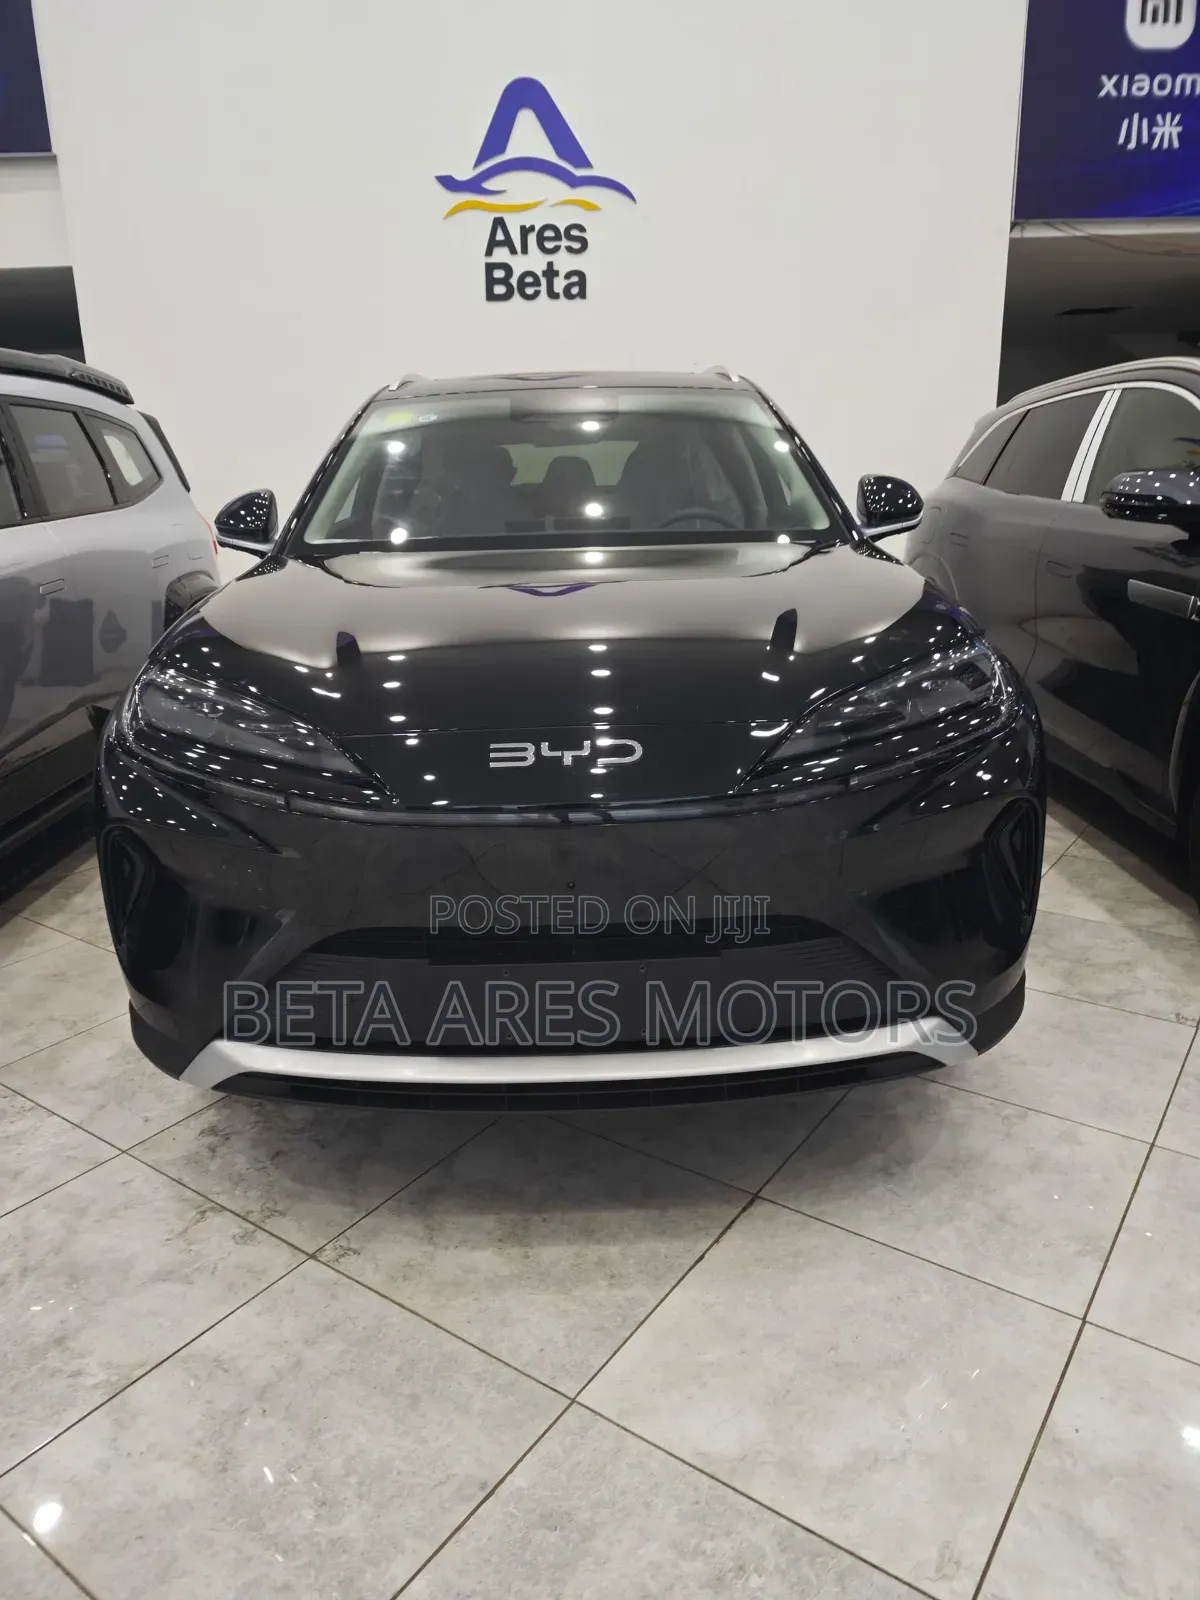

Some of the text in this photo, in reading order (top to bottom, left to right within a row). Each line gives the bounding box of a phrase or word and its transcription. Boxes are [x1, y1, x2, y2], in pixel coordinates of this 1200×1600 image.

[1098, 72, 1200, 98] xiaom
[1117, 111, 1183, 150] 小米
[484, 216, 589, 257] Ares
[484, 261, 588, 302] Beta
[489, 738, 643, 769] BYD
